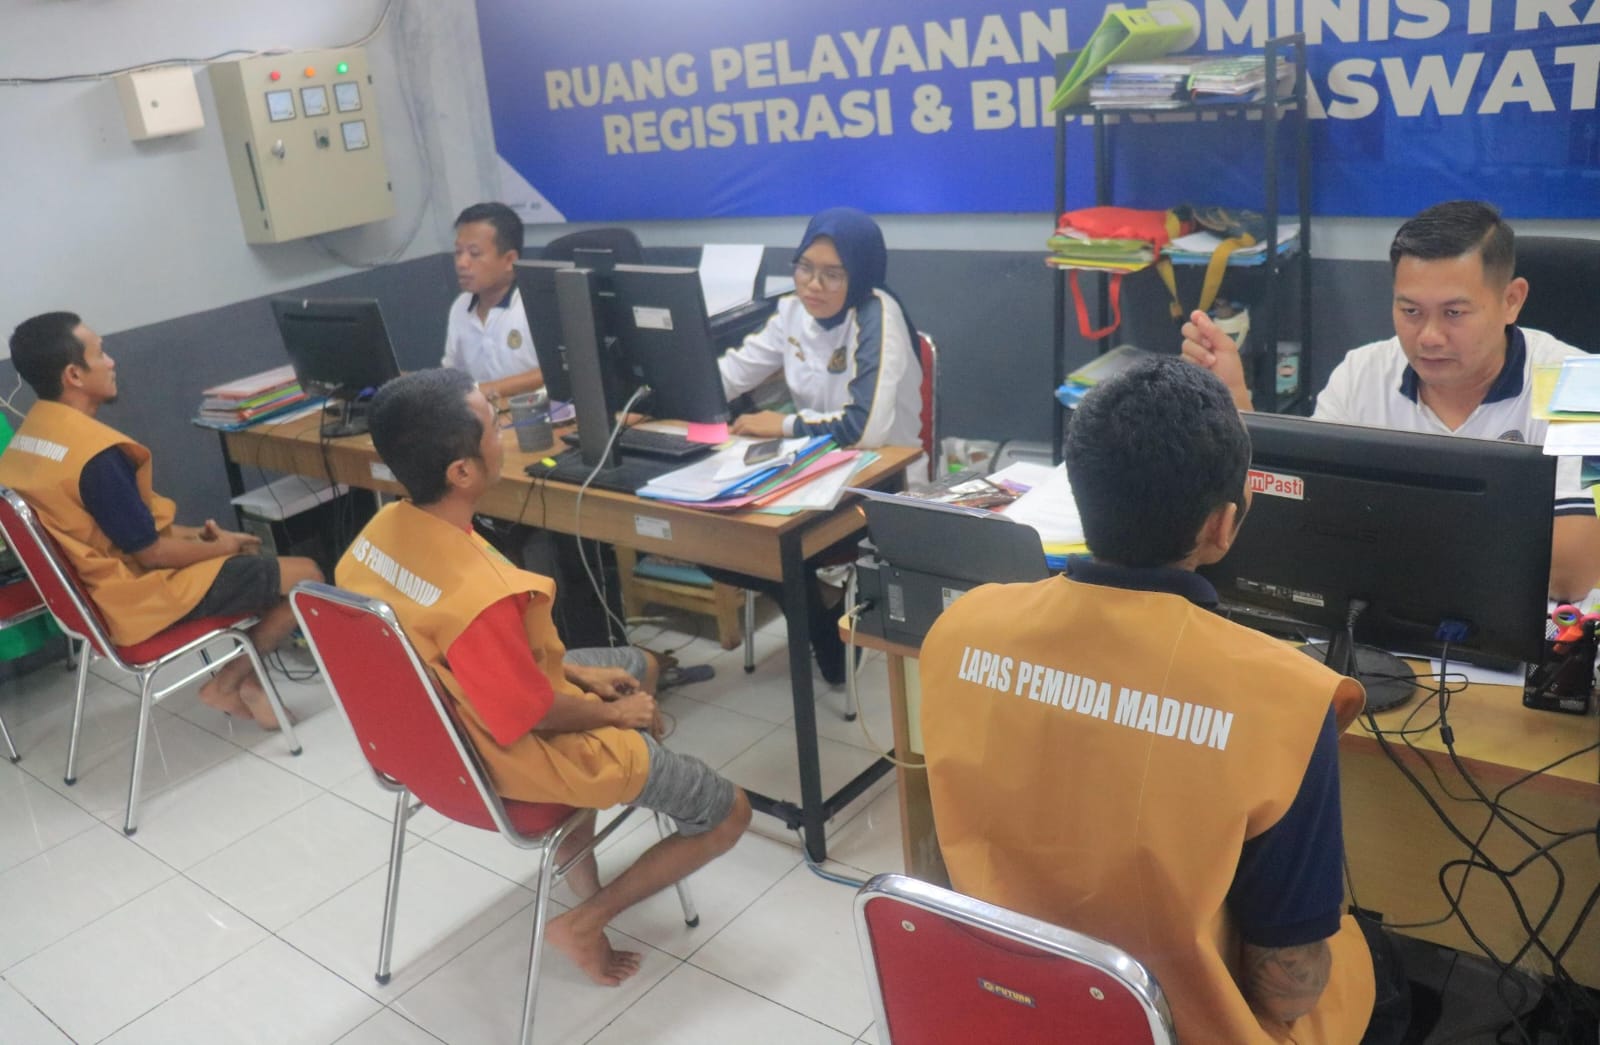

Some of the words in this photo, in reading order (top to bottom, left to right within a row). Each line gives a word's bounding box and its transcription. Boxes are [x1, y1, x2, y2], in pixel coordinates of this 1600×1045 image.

[545, 53, 698, 110] RUANG
[711, 8, 1069, 92] PELAYANAN
[1094, 0, 1600, 53] MINISR
[602, 88, 893, 155] REGISTRASI
[911, 84, 952, 134] &
[958, 646, 1014, 693] LAPAS
[1016, 661, 1112, 720] PEMUDA
[1114, 688, 1234, 751] MADIUN
